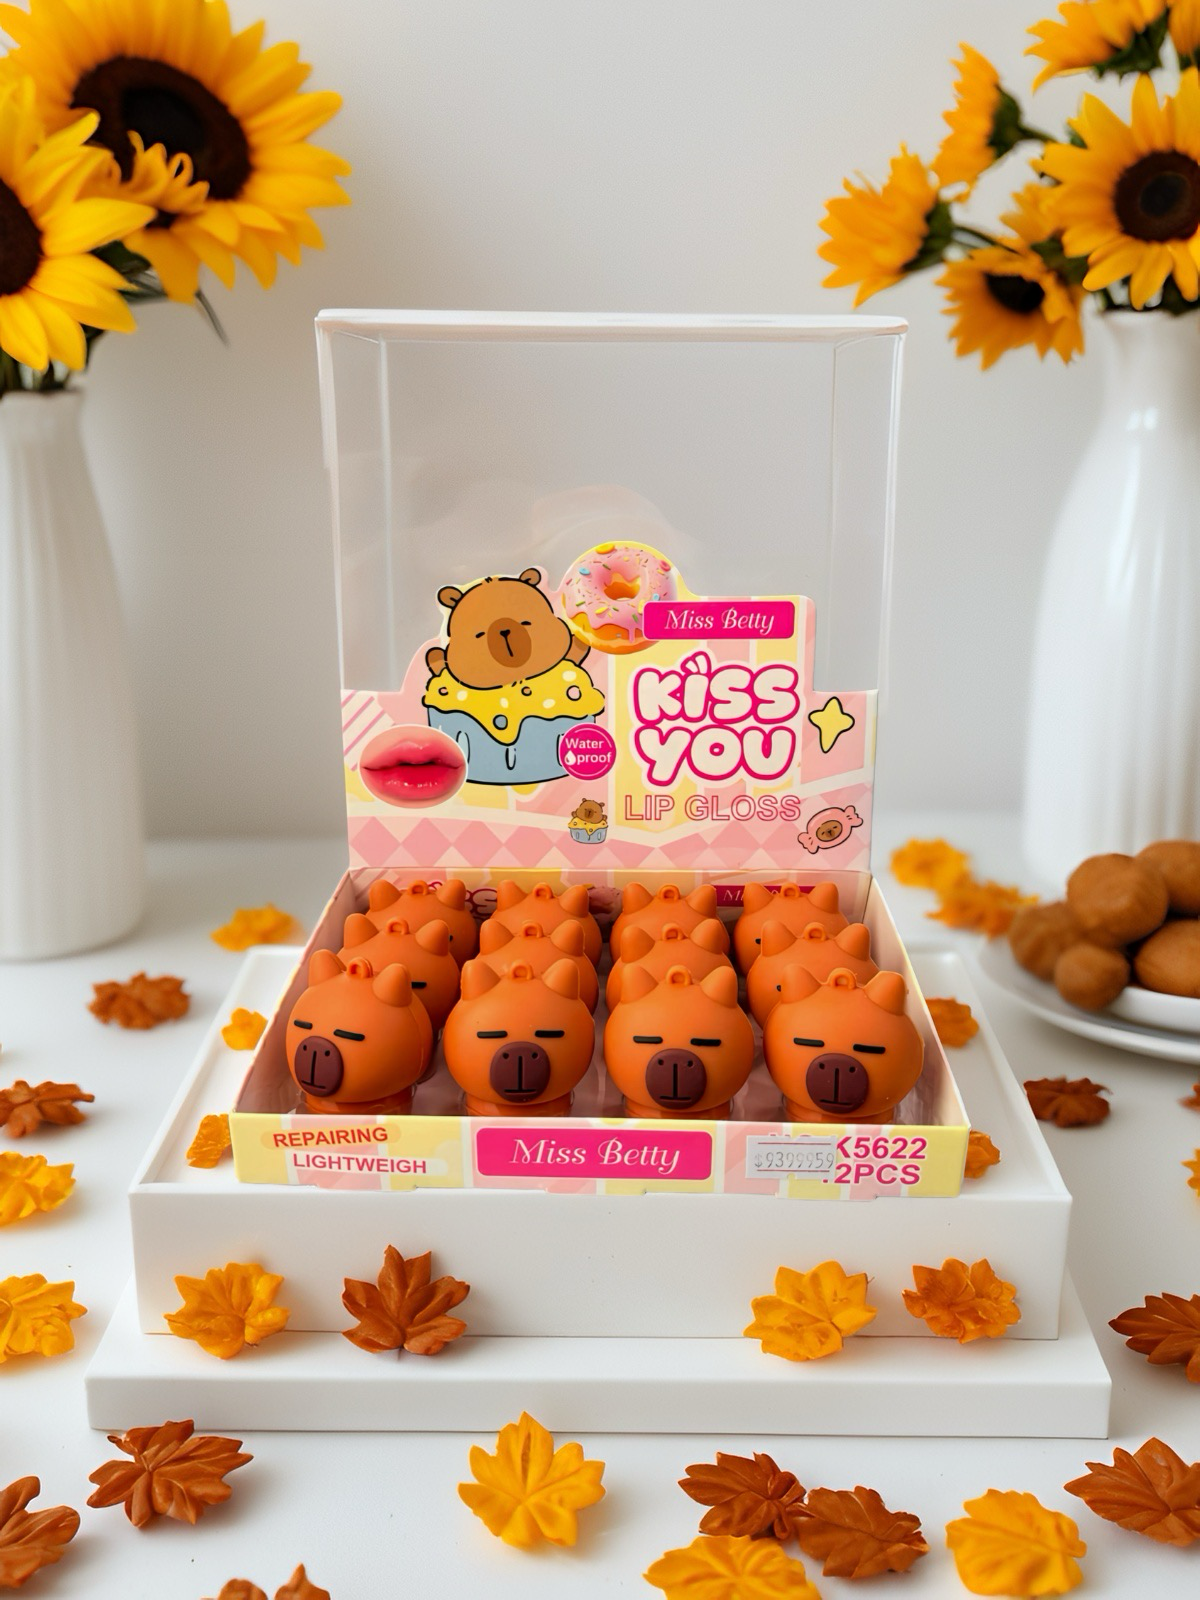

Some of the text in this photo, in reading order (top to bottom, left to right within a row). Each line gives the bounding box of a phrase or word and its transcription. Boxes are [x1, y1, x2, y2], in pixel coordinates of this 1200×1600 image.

[664, 607, 775, 634] Miss Betty
[565, 737, 604, 749] Water
[576, 751, 612, 766] proof
[624, 794, 801, 822] LIP GLOSS
[272, 1127, 388, 1148] REPAIRING
[292, 1153, 427, 1174] LIGHTWEIGH
[508, 1136, 681, 1175] Miss Betty
[822, 1163, 921, 1185] 2PCS
